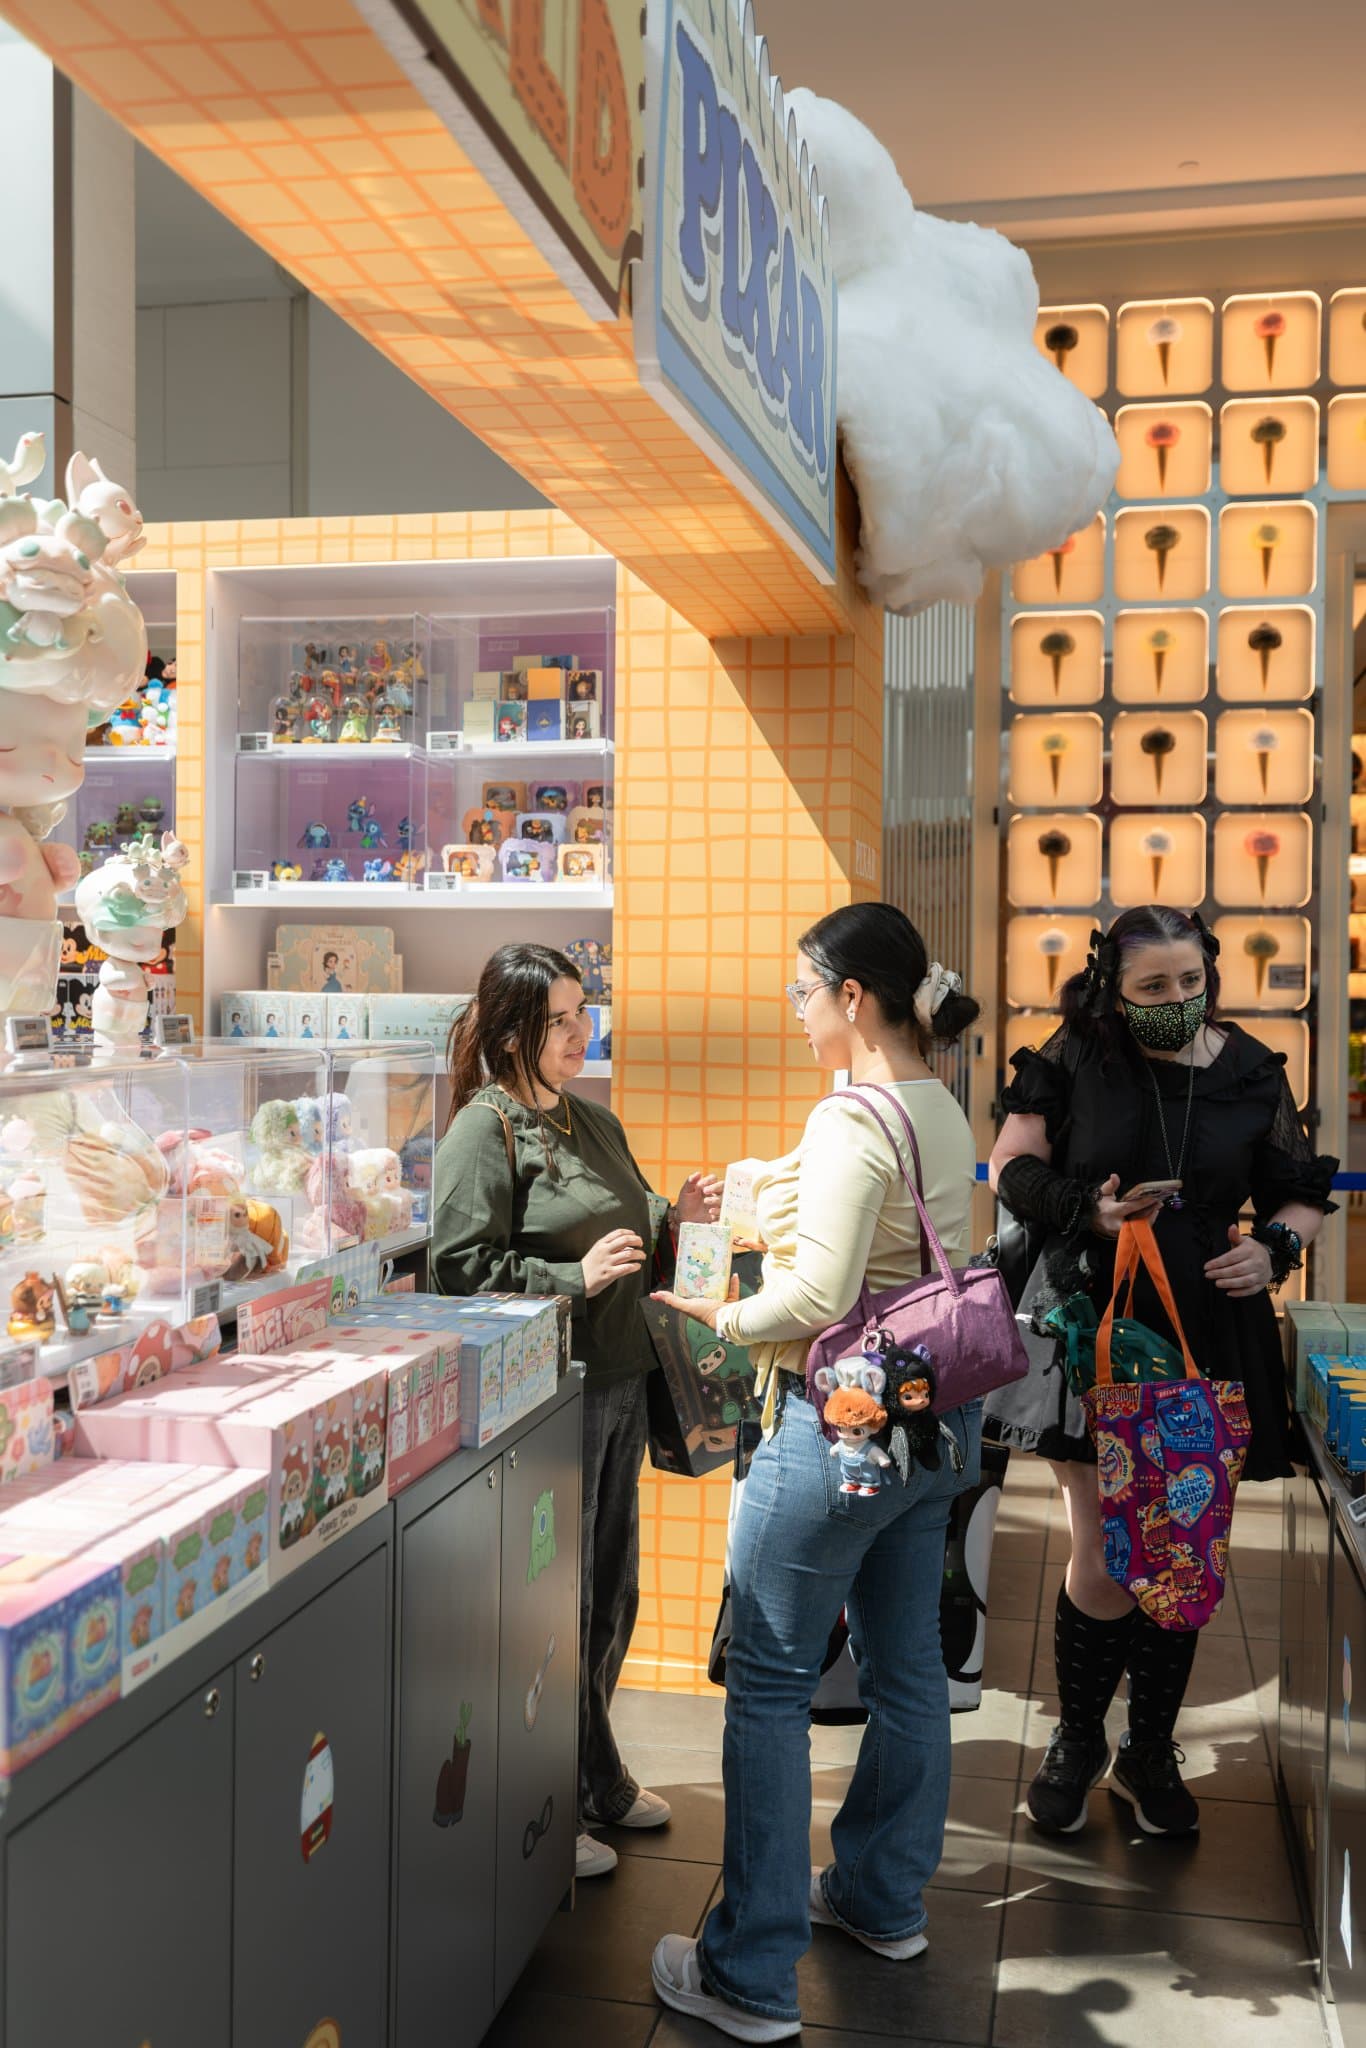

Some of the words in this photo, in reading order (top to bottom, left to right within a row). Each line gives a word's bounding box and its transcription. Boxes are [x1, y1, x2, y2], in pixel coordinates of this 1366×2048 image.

[676, 20, 827, 475] PIXAR
[1168, 1481, 1207, 1501] UCKING
[1169, 1491, 1210, 1511] LORIDA
